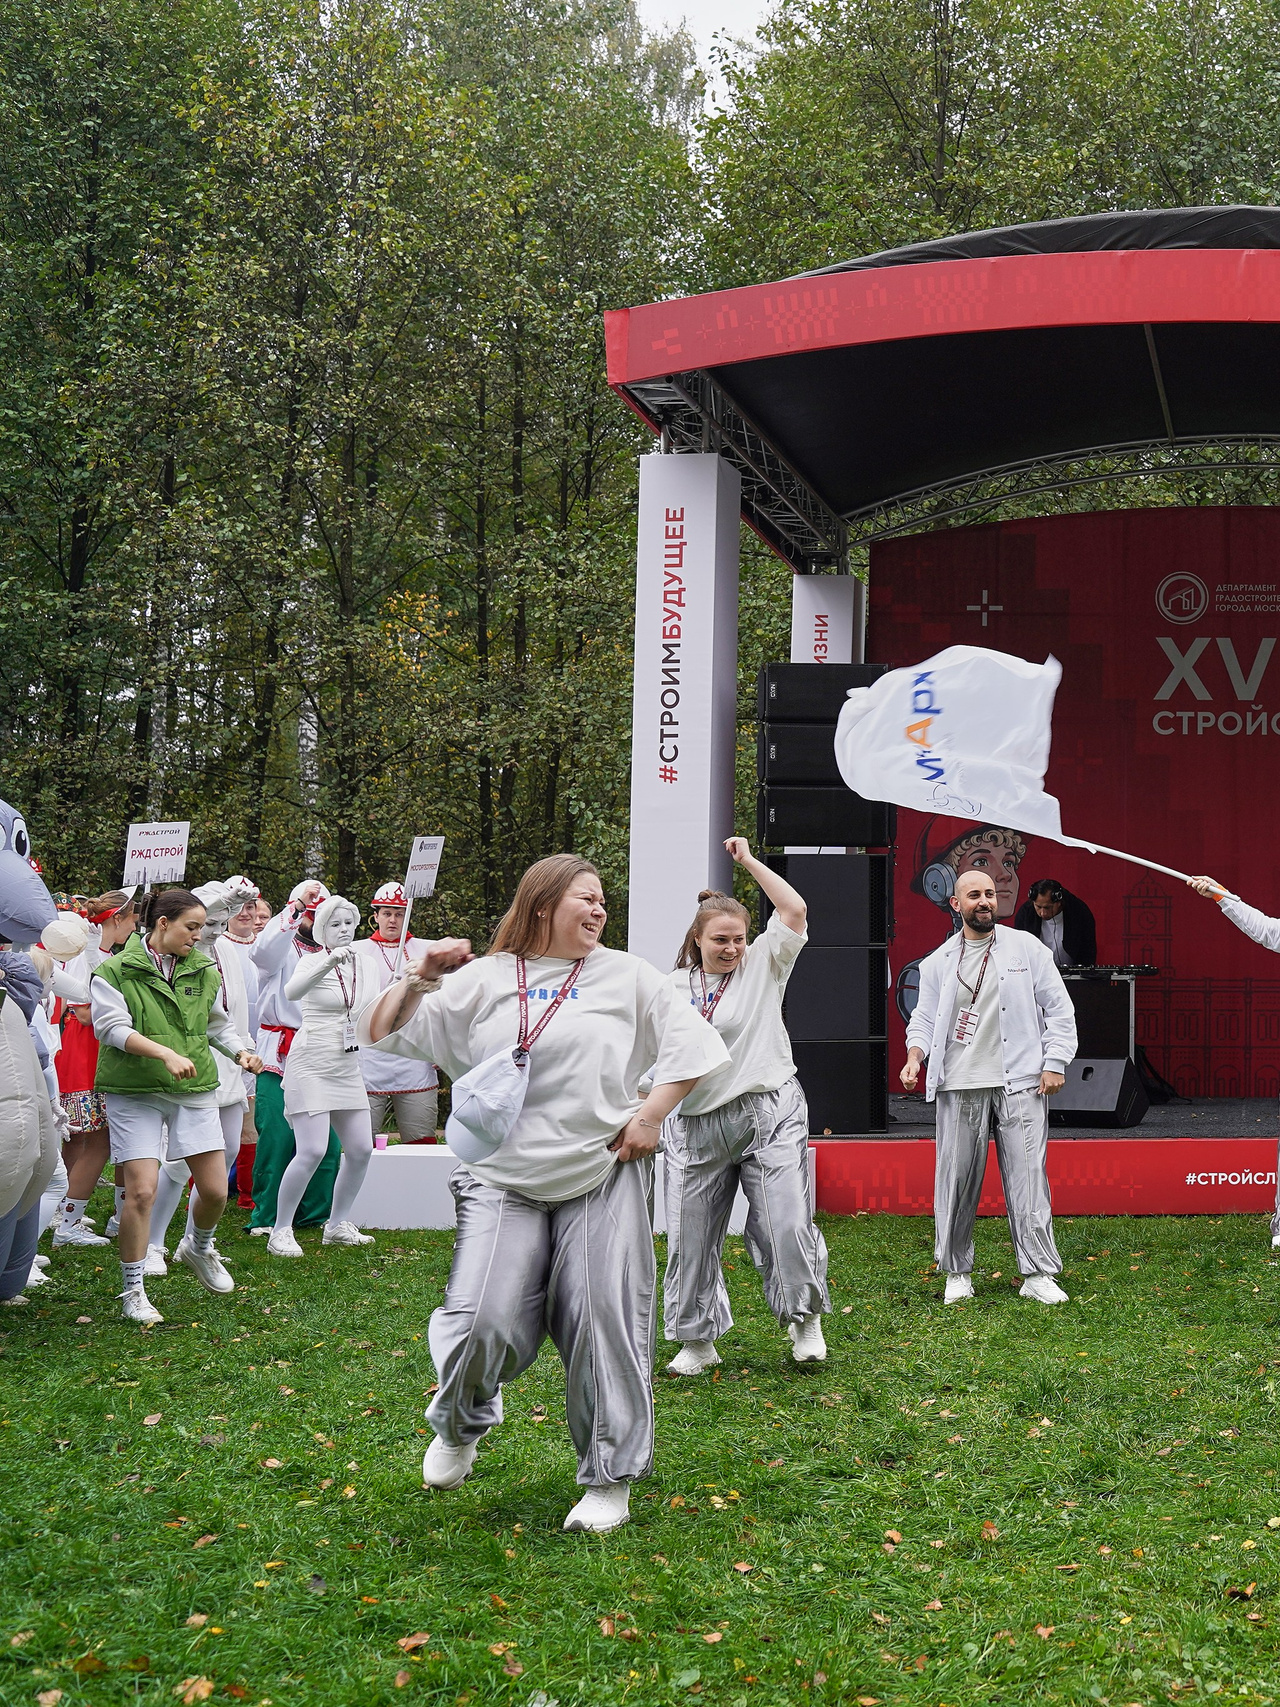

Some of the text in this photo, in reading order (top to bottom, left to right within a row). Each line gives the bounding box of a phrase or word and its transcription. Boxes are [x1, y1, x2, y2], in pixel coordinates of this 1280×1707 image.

[1215, 584, 1276, 592] ДЕПАРТАМЕНТ
[1215, 604, 1252, 612] ГОРОДА
[659, 507, 687, 784] #СТРОИМБУДУЩЕЕ
[814, 614, 829, 664] ИЗНИ
[131, 844, 184, 860] РЖД СТРОЙ
